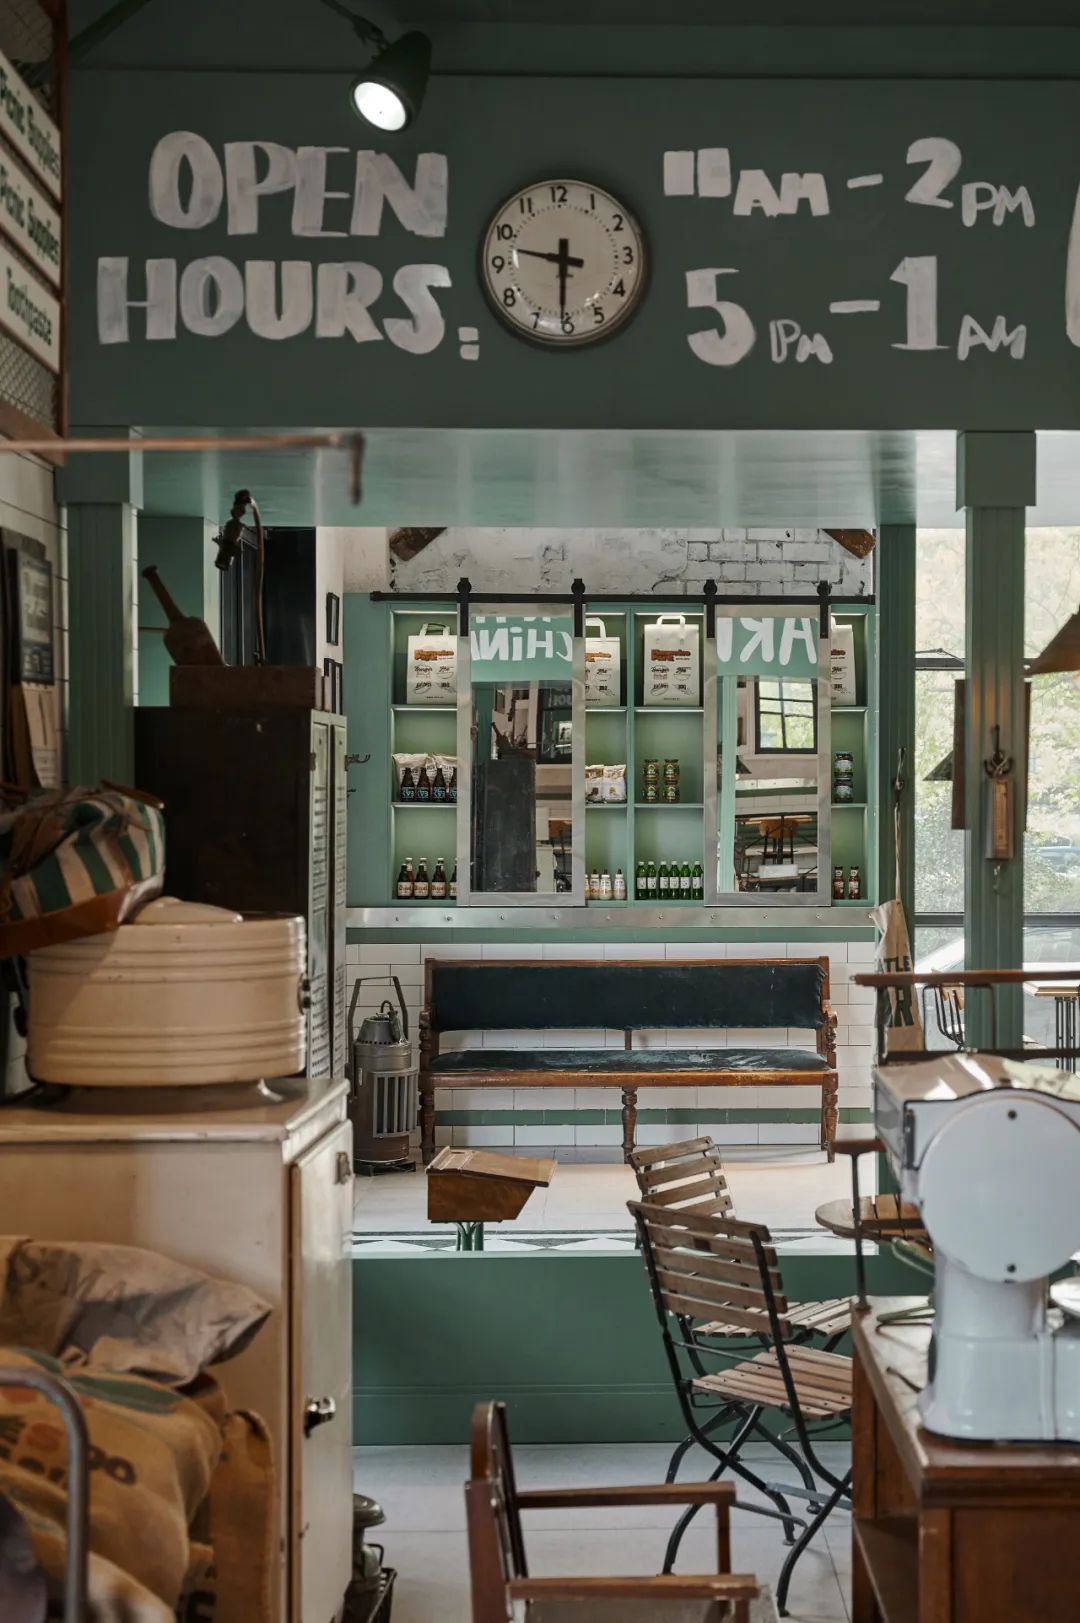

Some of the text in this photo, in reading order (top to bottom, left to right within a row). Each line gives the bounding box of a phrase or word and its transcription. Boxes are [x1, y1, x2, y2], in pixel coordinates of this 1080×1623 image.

[148, 130, 449, 237] OPEN
[905, 136, 1036, 228] 2PM
[550, 185, 568, 203] 12
[590, 193, 596, 210] 1
[519, 197, 532, 214] 11
[496, 223, 513, 241] 10
[612, 214, 624, 232] 2
[491, 255, 505, 274] 9
[623, 246, 634, 265] 3
[612, 279, 626, 297] 4
[503, 288, 516, 307] 8
[593, 307, 605, 324] 5
[890, 255, 1027, 360] 1AM
[531, 312, 541, 329] 7
[561, 316, 575, 334] 6
